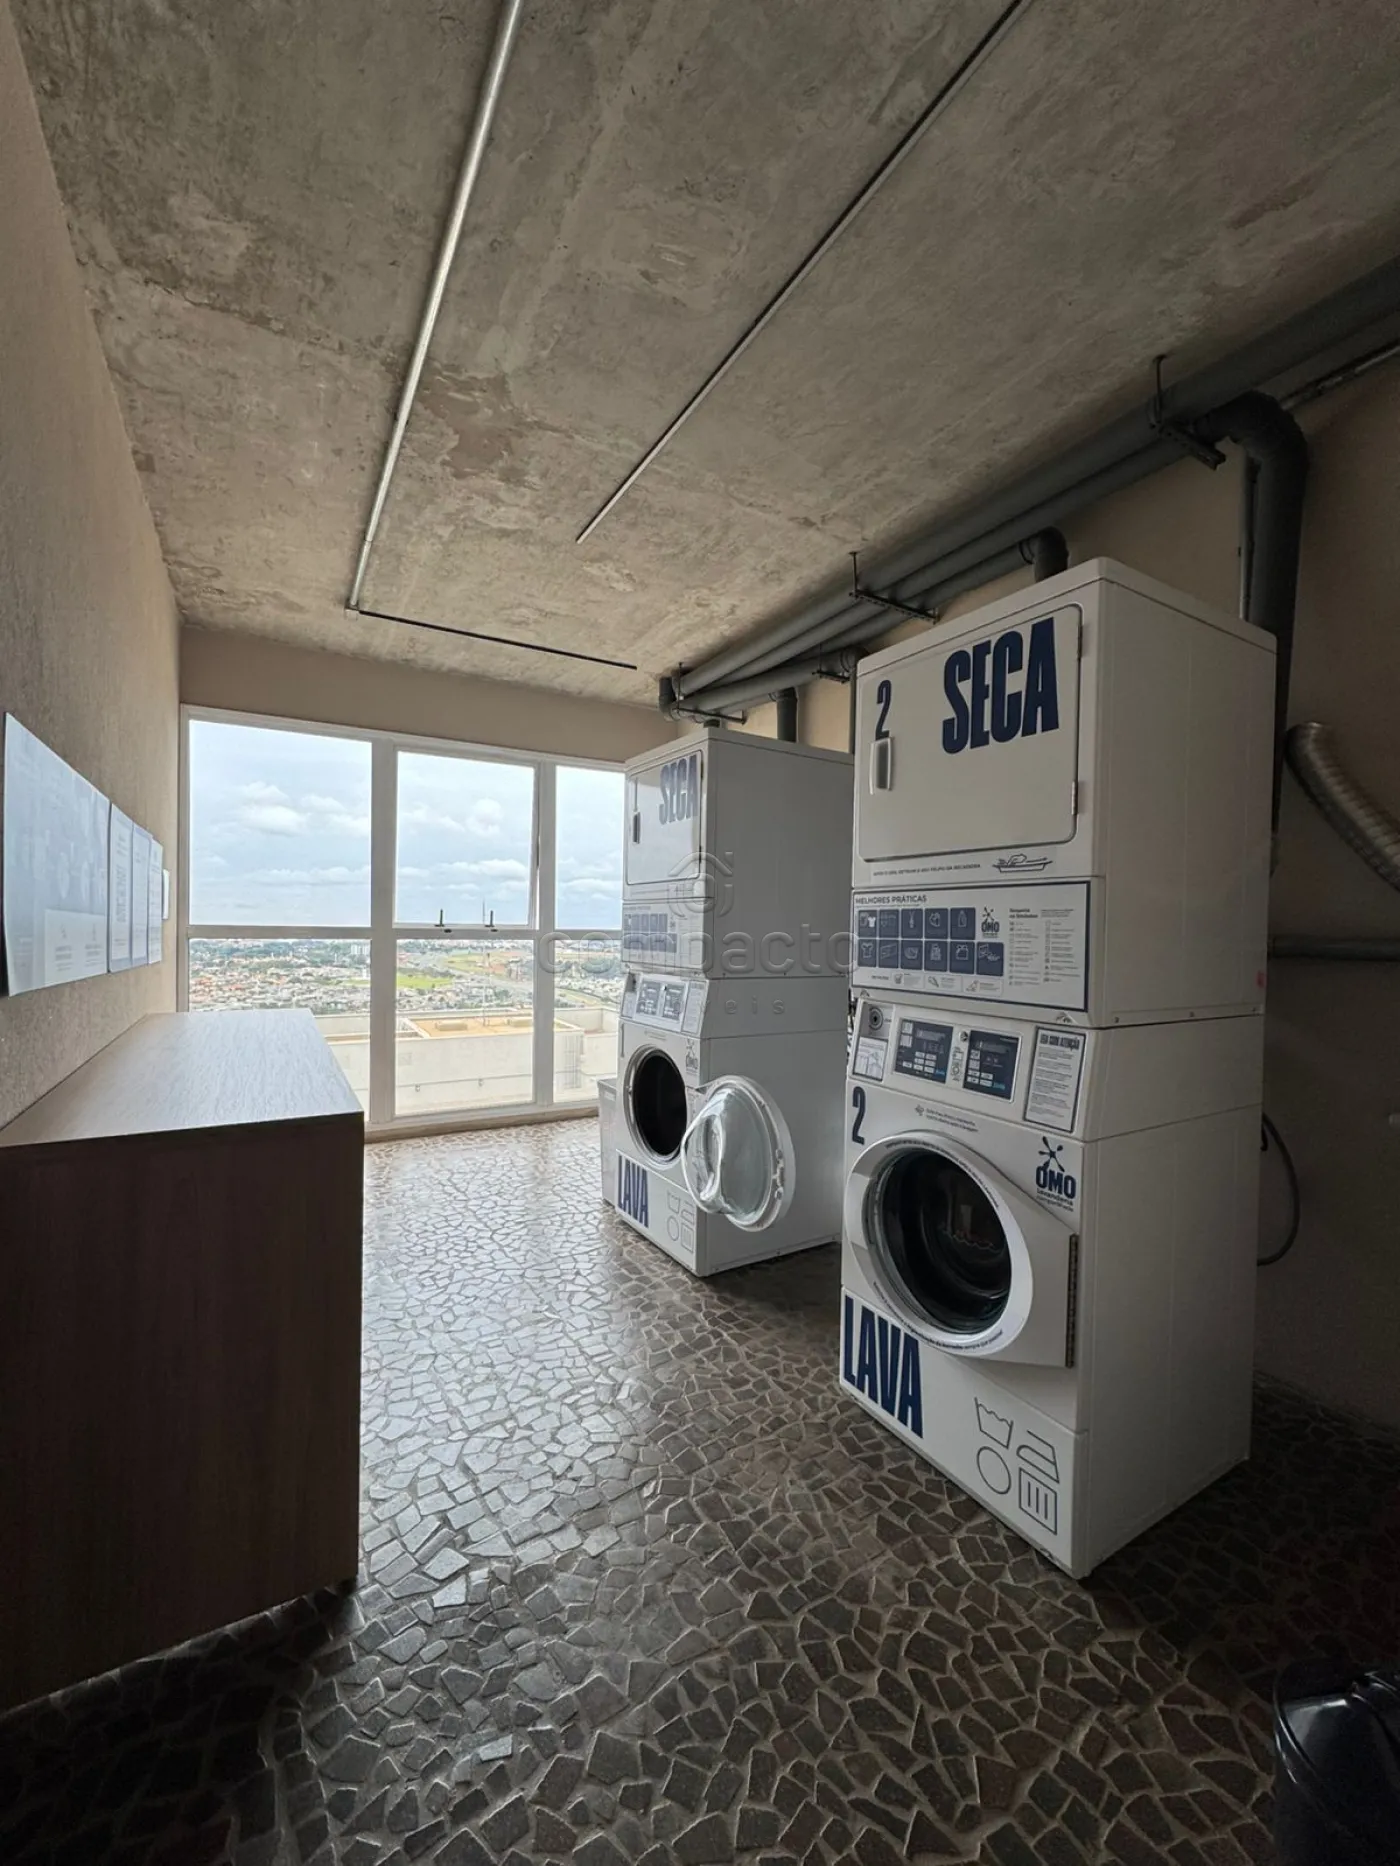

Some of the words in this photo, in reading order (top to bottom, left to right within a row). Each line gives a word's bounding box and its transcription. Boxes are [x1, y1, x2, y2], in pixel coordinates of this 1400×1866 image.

[875, 680, 892, 741] 2
[942, 617, 1059, 754] SECA
[659, 755, 698, 825] SECA
[855, 896, 890, 905] MELHORES
[891, 894, 928, 904] PRÁTICAS
[981, 921, 1000, 933] OMO
[852, 1086, 866, 1145] 2
[617, 1154, 650, 1228] LAVA
[1035, 1165, 1077, 1199] OMO
[844, 1293, 924, 1439] LAVA
